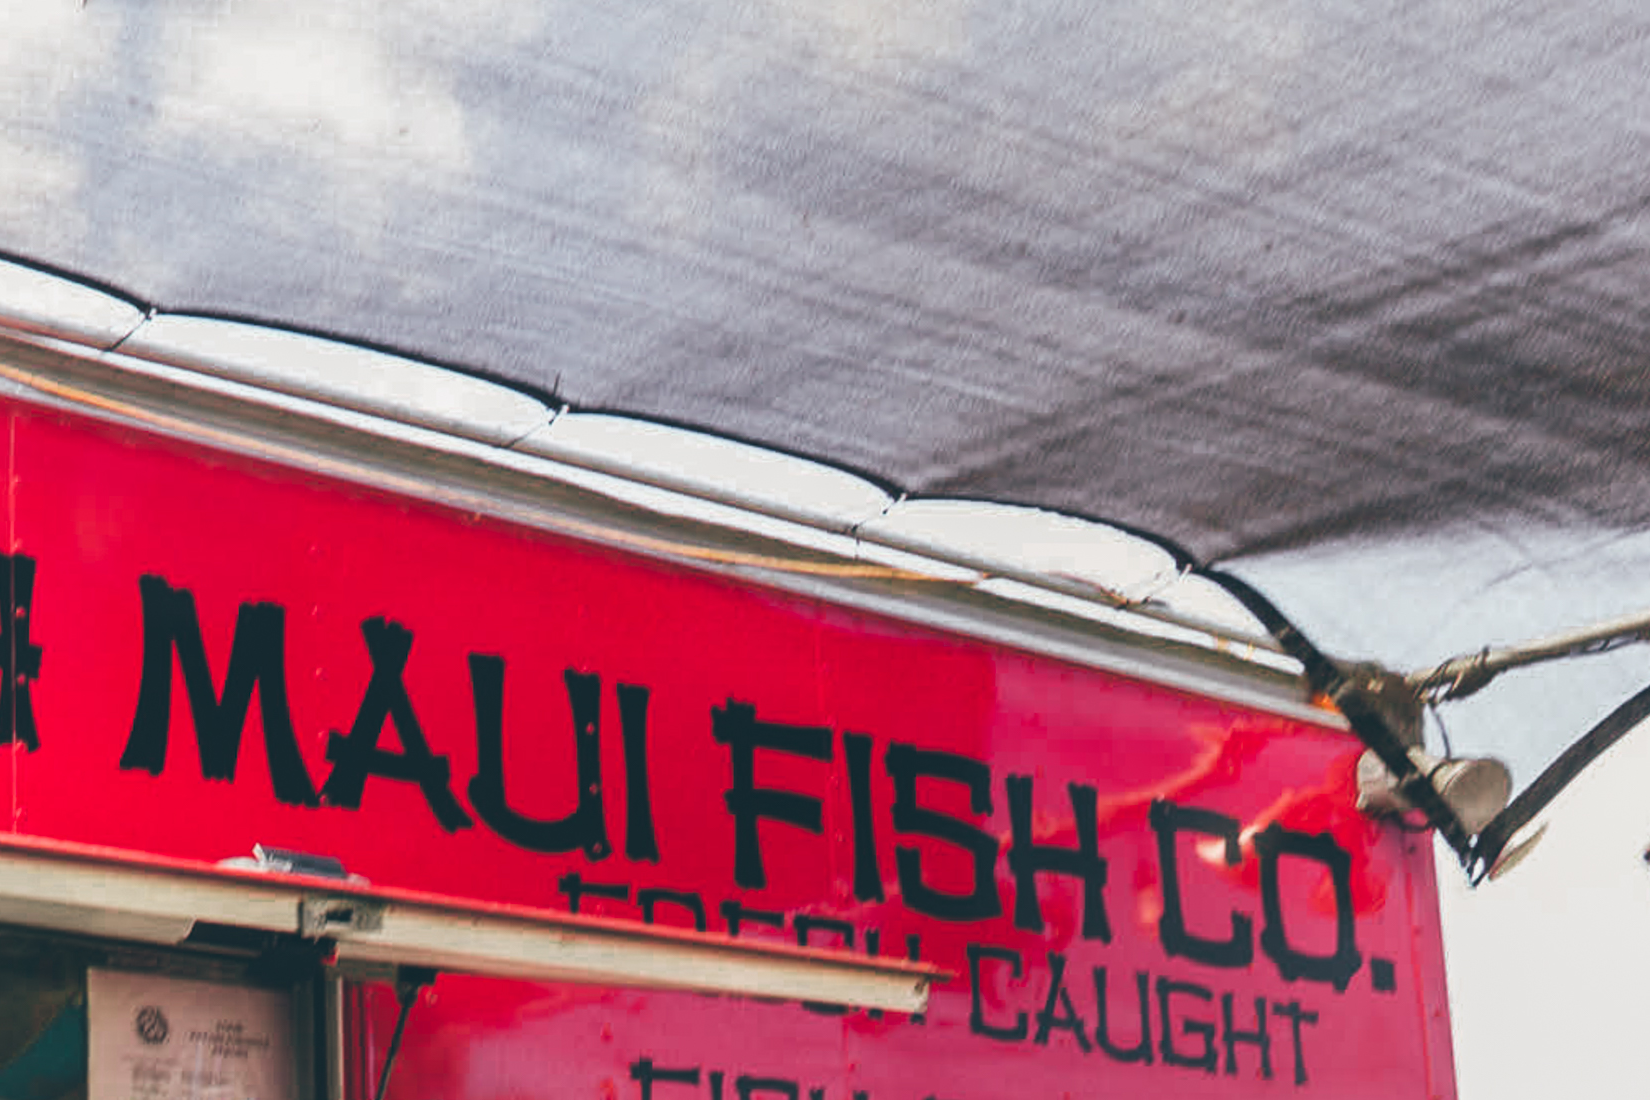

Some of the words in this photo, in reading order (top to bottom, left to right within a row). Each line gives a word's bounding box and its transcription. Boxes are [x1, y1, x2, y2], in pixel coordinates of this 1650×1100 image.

[119, 573, 661, 864] MAUI
[711, 697, 1113, 944] FISH
[1151, 796, 1397, 993] CO.
[967, 943, 1319, 1087] CAUGHT
